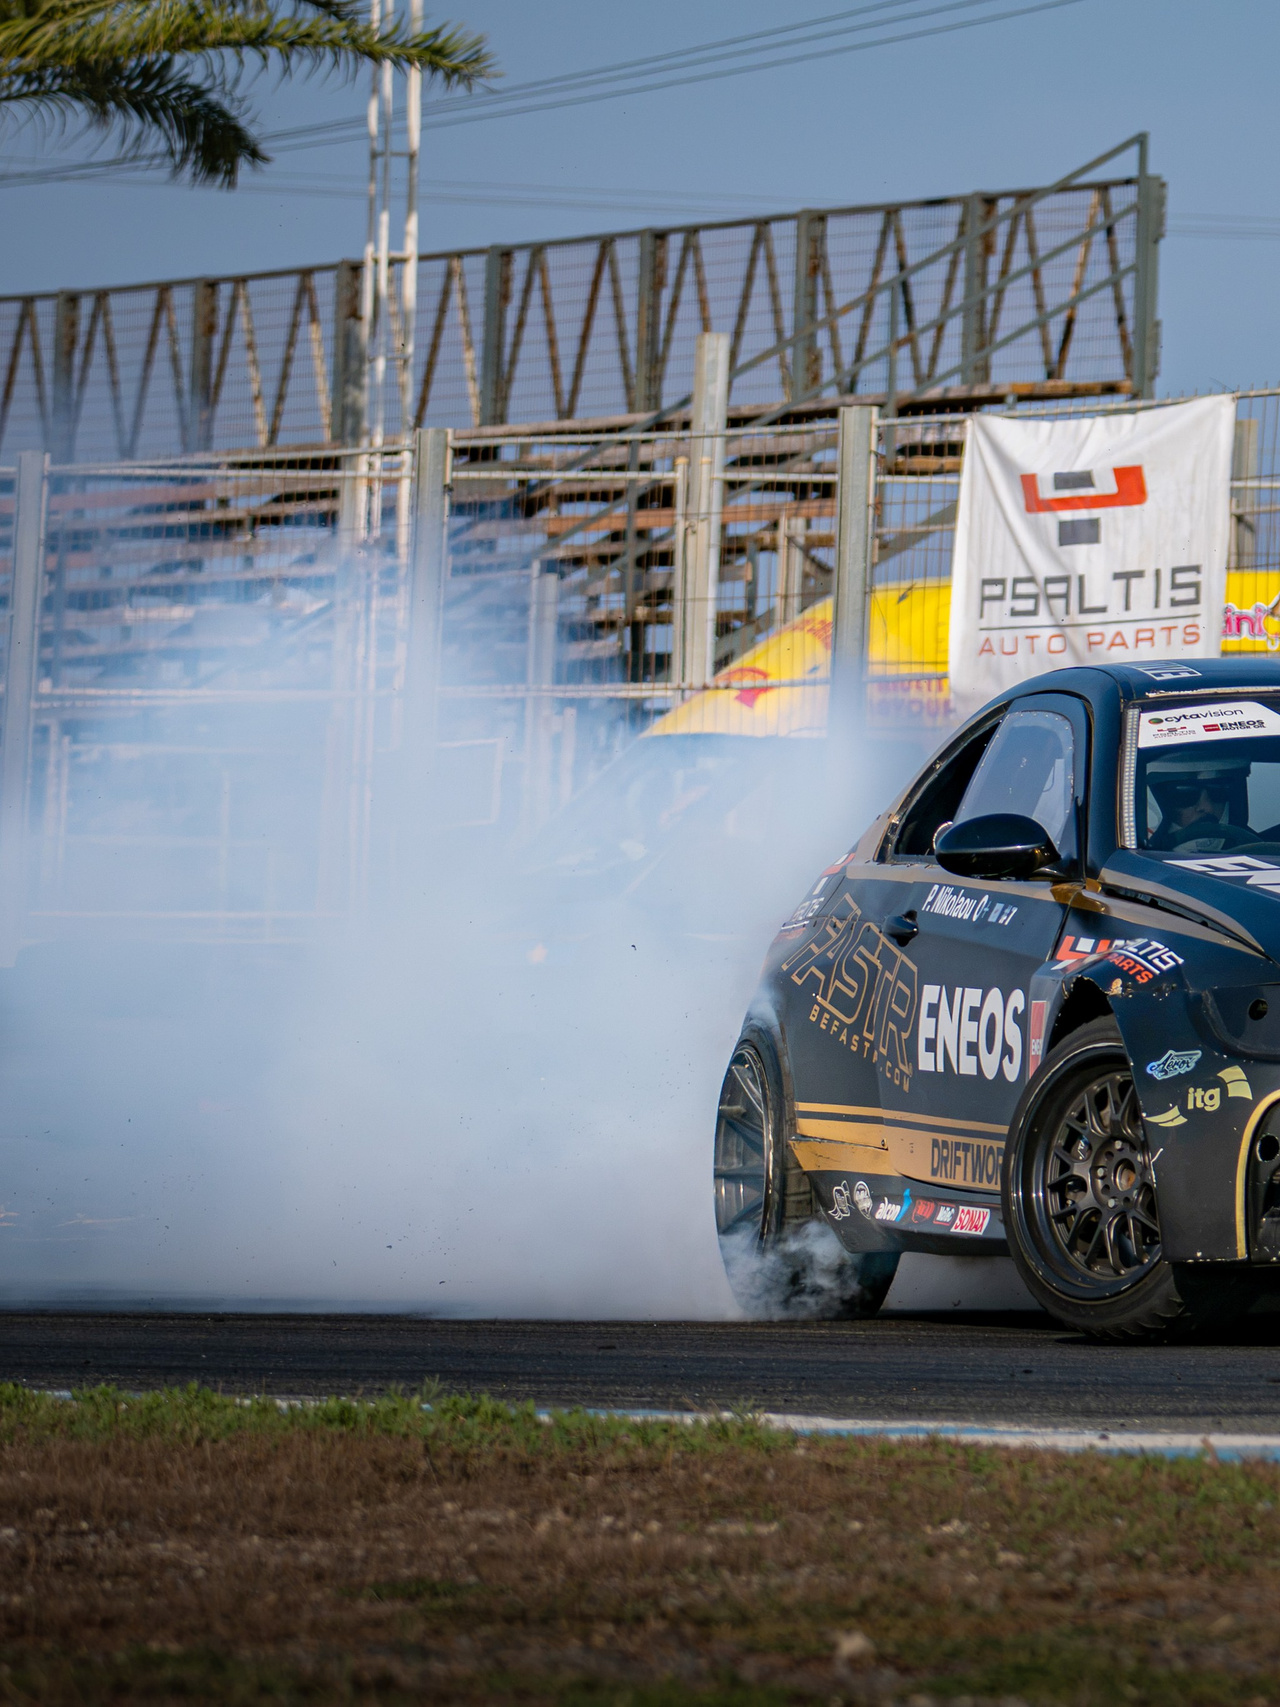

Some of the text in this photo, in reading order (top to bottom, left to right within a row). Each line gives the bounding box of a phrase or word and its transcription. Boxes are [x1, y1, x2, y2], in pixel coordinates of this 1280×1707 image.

[979, 564, 1202, 619] PSALTIS
[978, 624, 1201, 656] AUTO PARTS
[1164, 708, 1244, 723] cytavision
[1220, 719, 1265, 728] ENEOS
[917, 984, 1026, 1082] ENEOS
[1187, 1085, 1221, 1112] itg
[875, 1197, 902, 1221] alcon
[954, 1208, 988, 1233] SONAX
